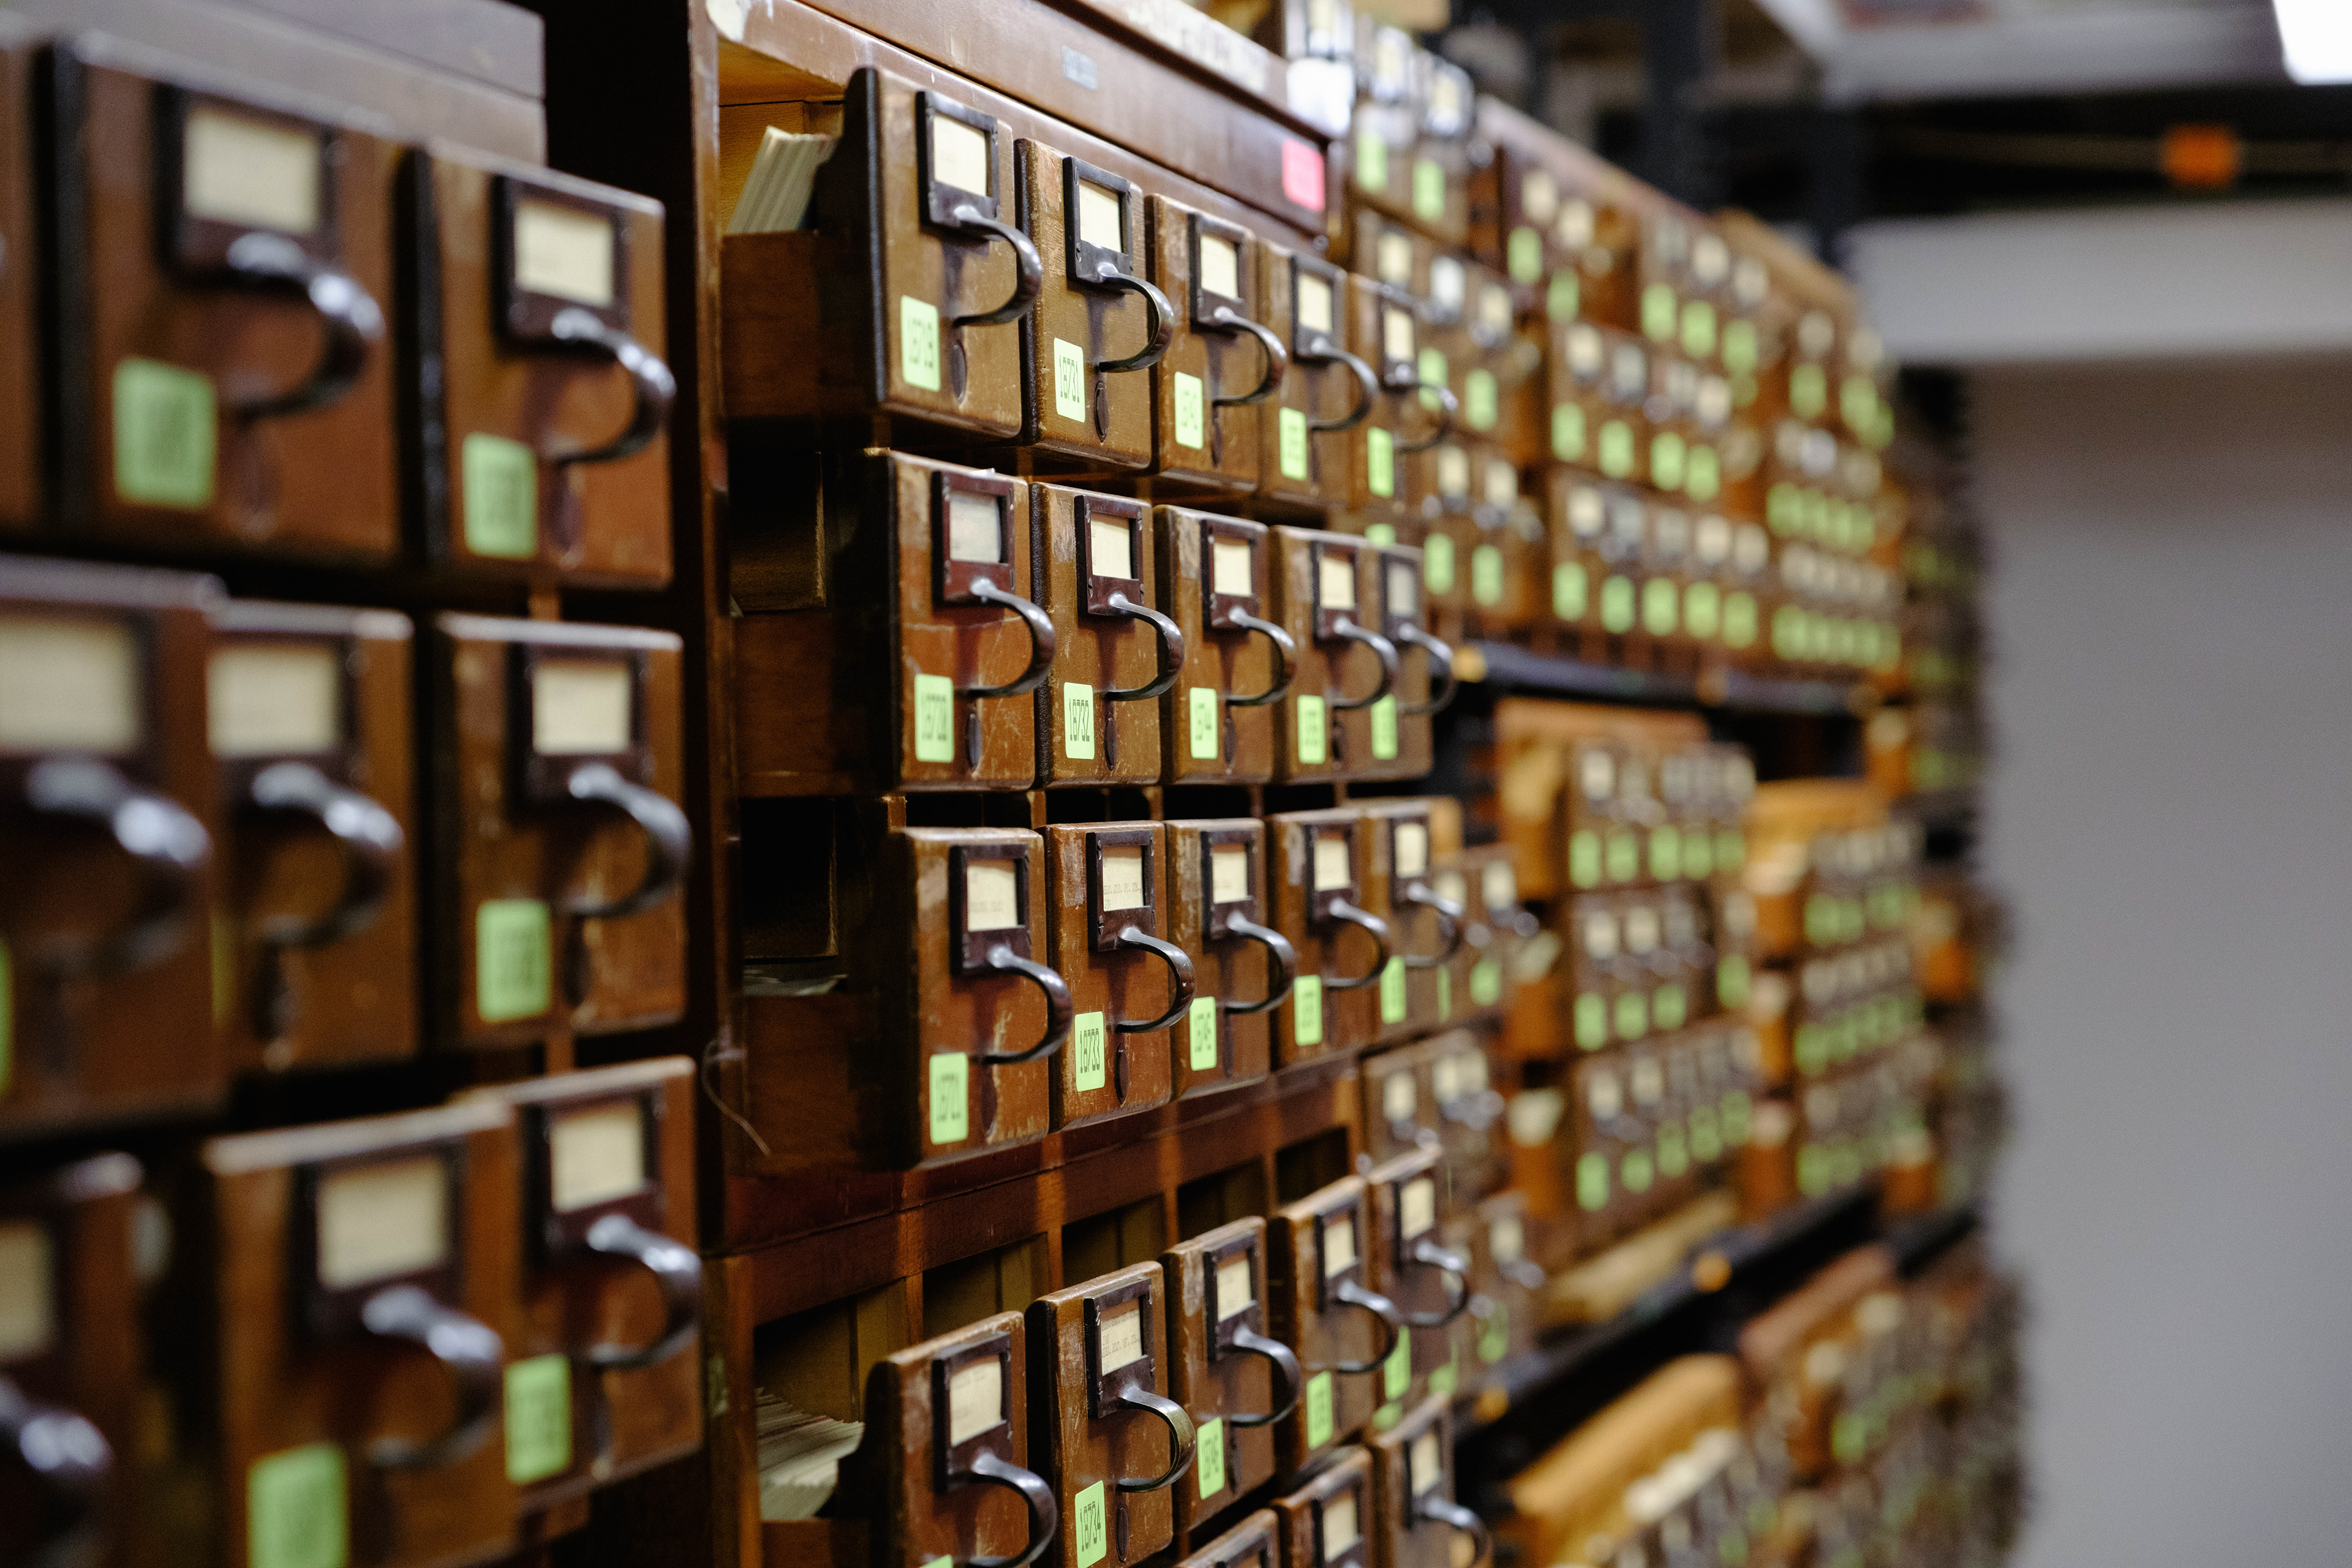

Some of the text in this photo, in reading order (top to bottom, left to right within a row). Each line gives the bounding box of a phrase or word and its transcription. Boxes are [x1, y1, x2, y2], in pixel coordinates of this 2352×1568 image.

[1059, 355, 1080, 403] 18731
[1069, 699, 1090, 742] 18732
[1080, 1028, 1100, 1074] 18733
[1080, 1498, 1101, 1553] 18734
